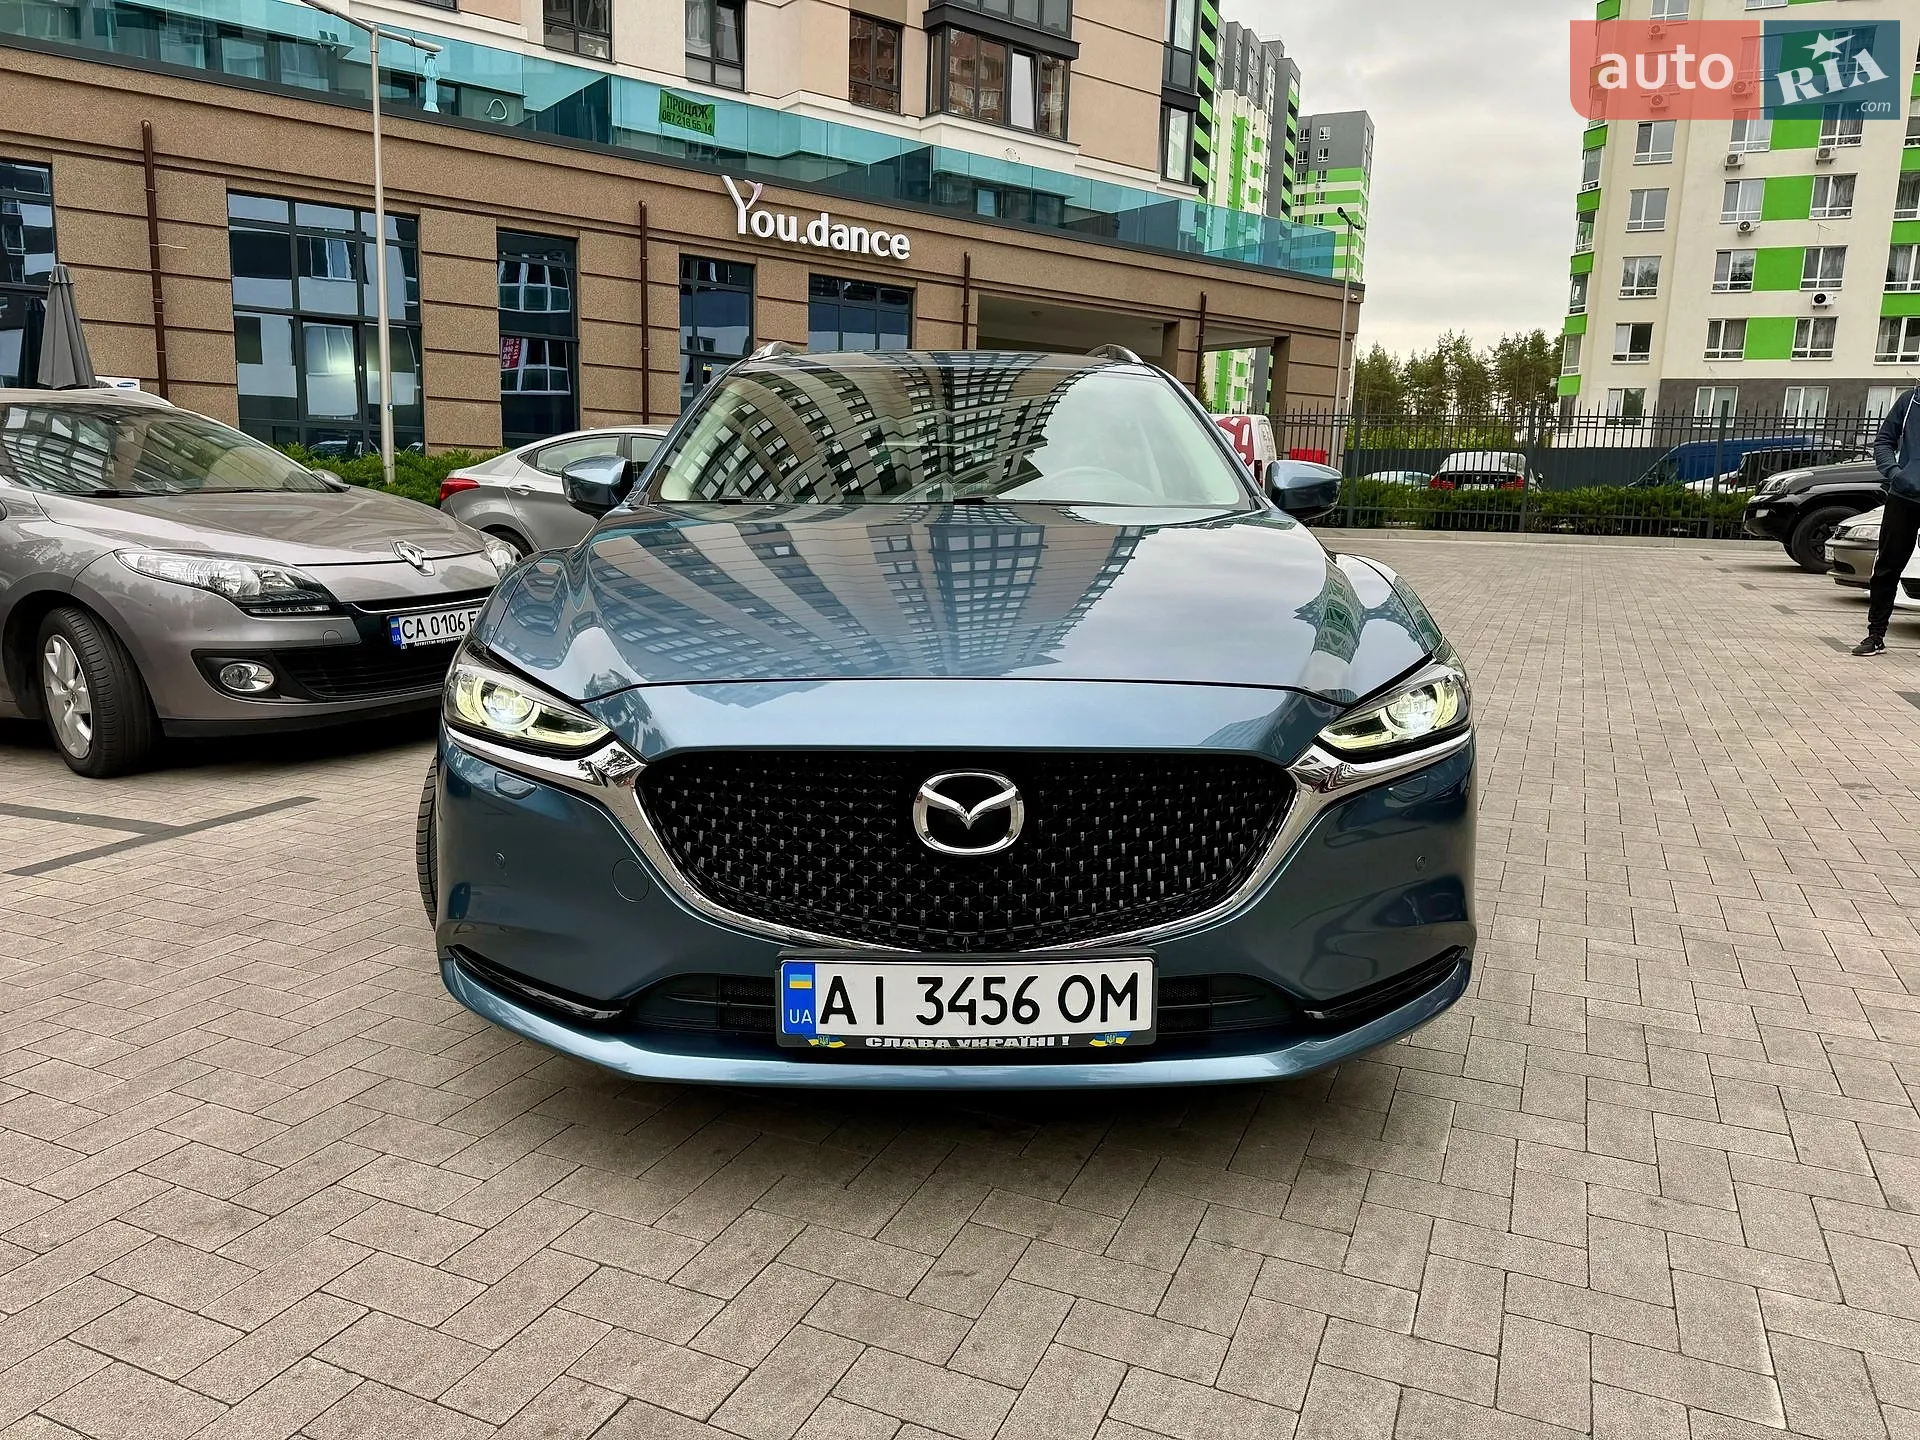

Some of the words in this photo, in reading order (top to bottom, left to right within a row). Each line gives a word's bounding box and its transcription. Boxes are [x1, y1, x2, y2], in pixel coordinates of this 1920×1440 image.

[666, 96, 708, 120] ПРОДАЖ
[721, 174, 911, 260] You.dance
[402, 617, 428, 640] CA
[430, 612, 466, 636] 0106
[467, 610, 480, 629] E
[819, 975, 884, 1025] AI
[915, 975, 1040, 1026] 3456
[1057, 972, 1139, 1024] OM
[789, 1009, 813, 1024] UA
[865, 1037, 951, 1049] СЛАВА
[958, 1036, 1055, 1049] УКРАЇНІ
